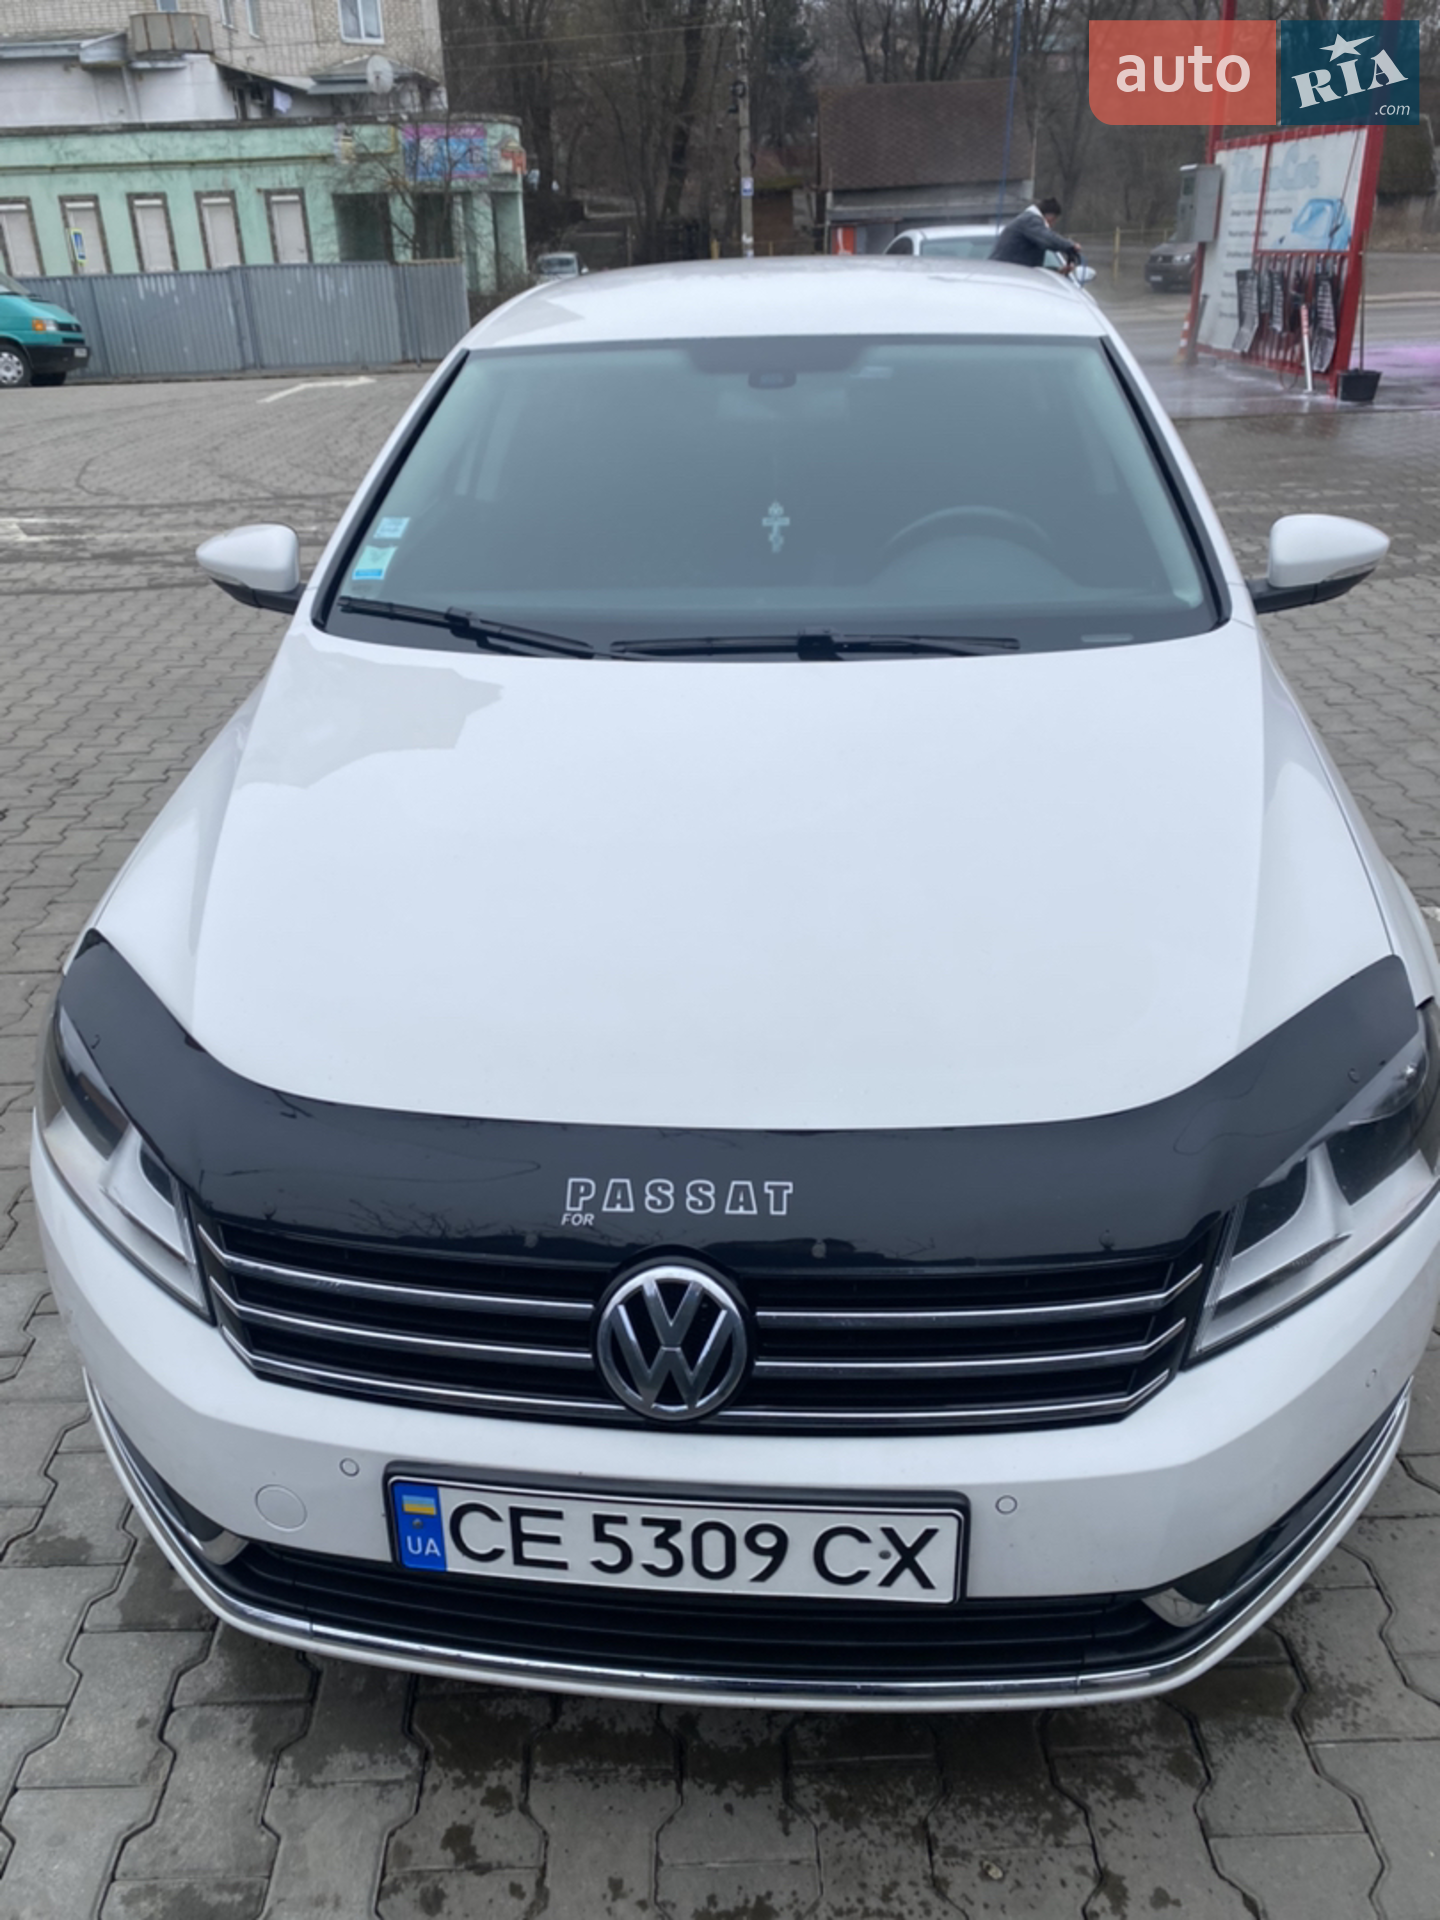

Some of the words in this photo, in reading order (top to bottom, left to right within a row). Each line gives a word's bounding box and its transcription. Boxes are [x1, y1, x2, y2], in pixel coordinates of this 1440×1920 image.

[566, 1178, 793, 1215] PASSAT
[561, 1213, 594, 1225] FOR
[406, 1535, 441, 1558] UA
[449, 1502, 569, 1571] CE
[590, 1512, 789, 1583] 5309
[812, 1525, 940, 1590] CX
